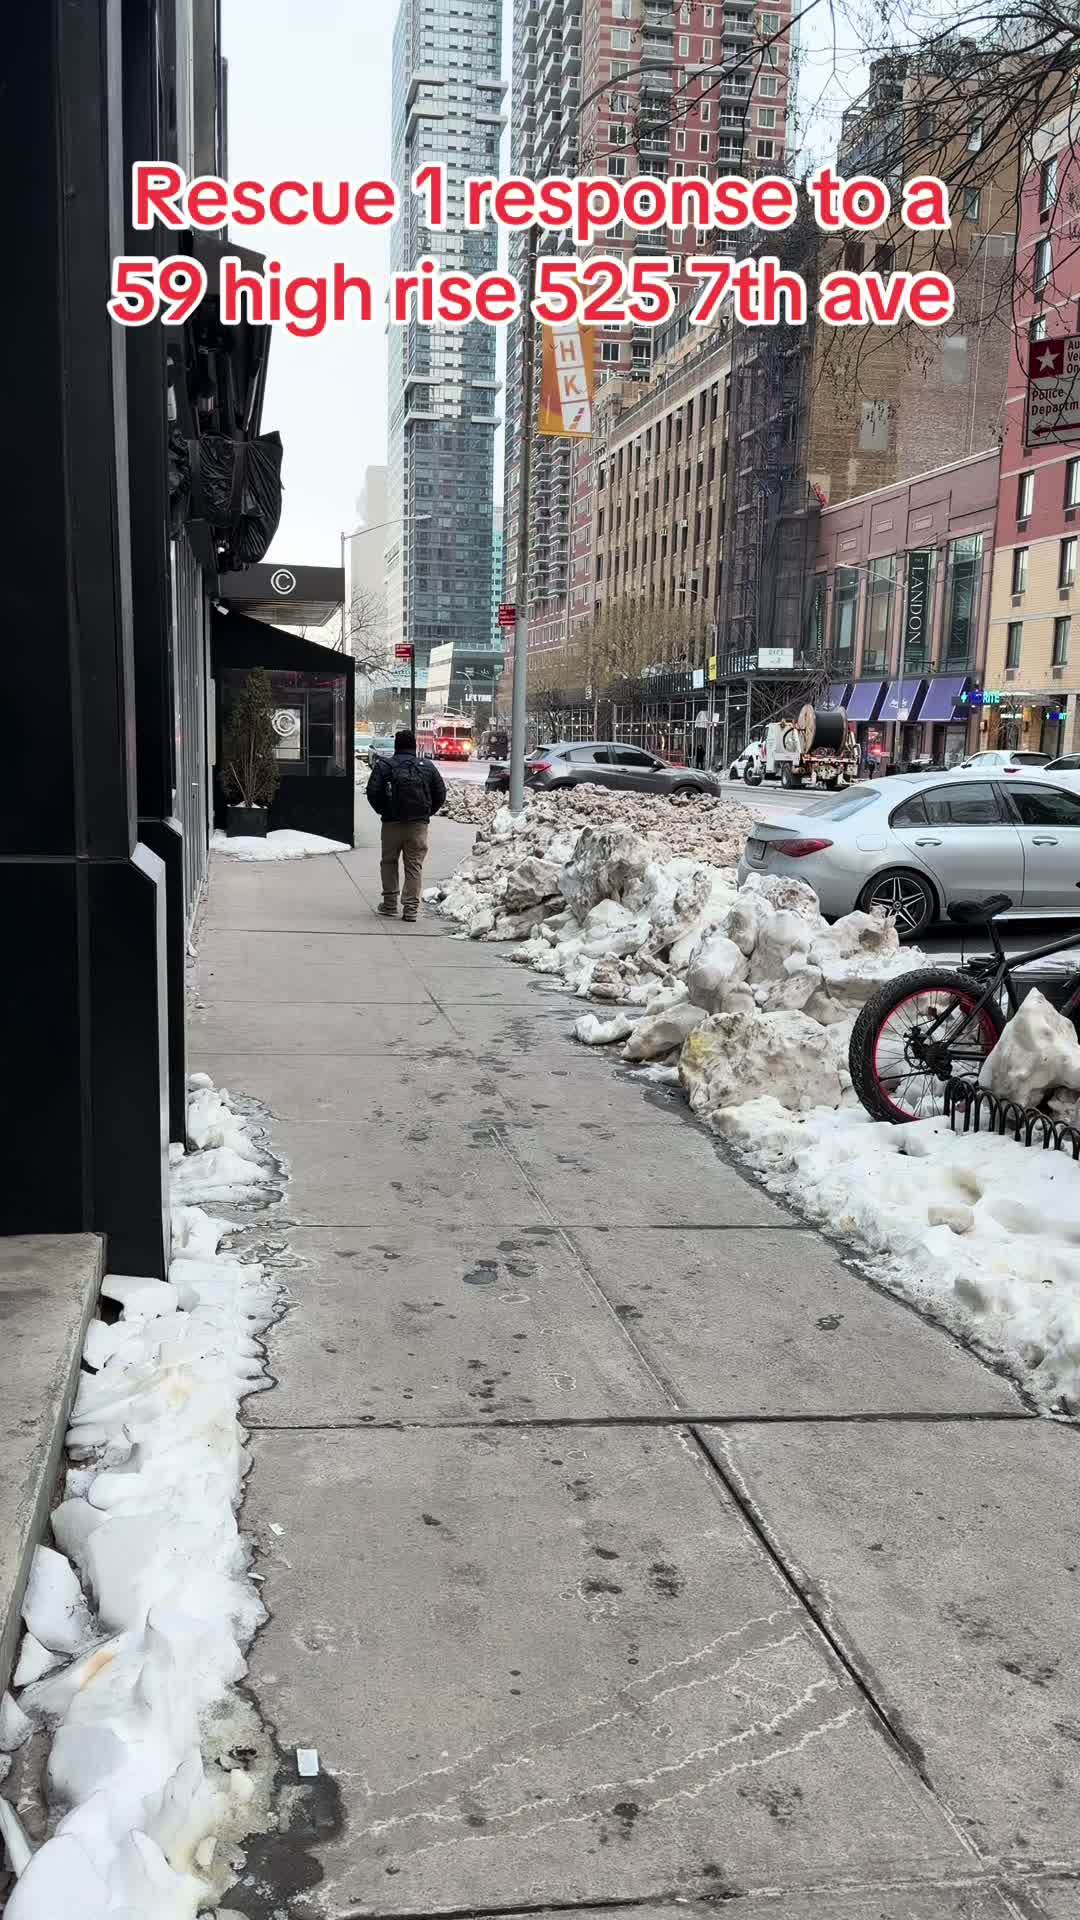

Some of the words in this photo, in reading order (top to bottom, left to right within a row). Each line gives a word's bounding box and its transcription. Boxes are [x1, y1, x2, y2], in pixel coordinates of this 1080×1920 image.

[1032, 388, 1064, 401] Police
[1031, 400, 1079, 416] Departm
[908, 566, 926, 645] LANDON
